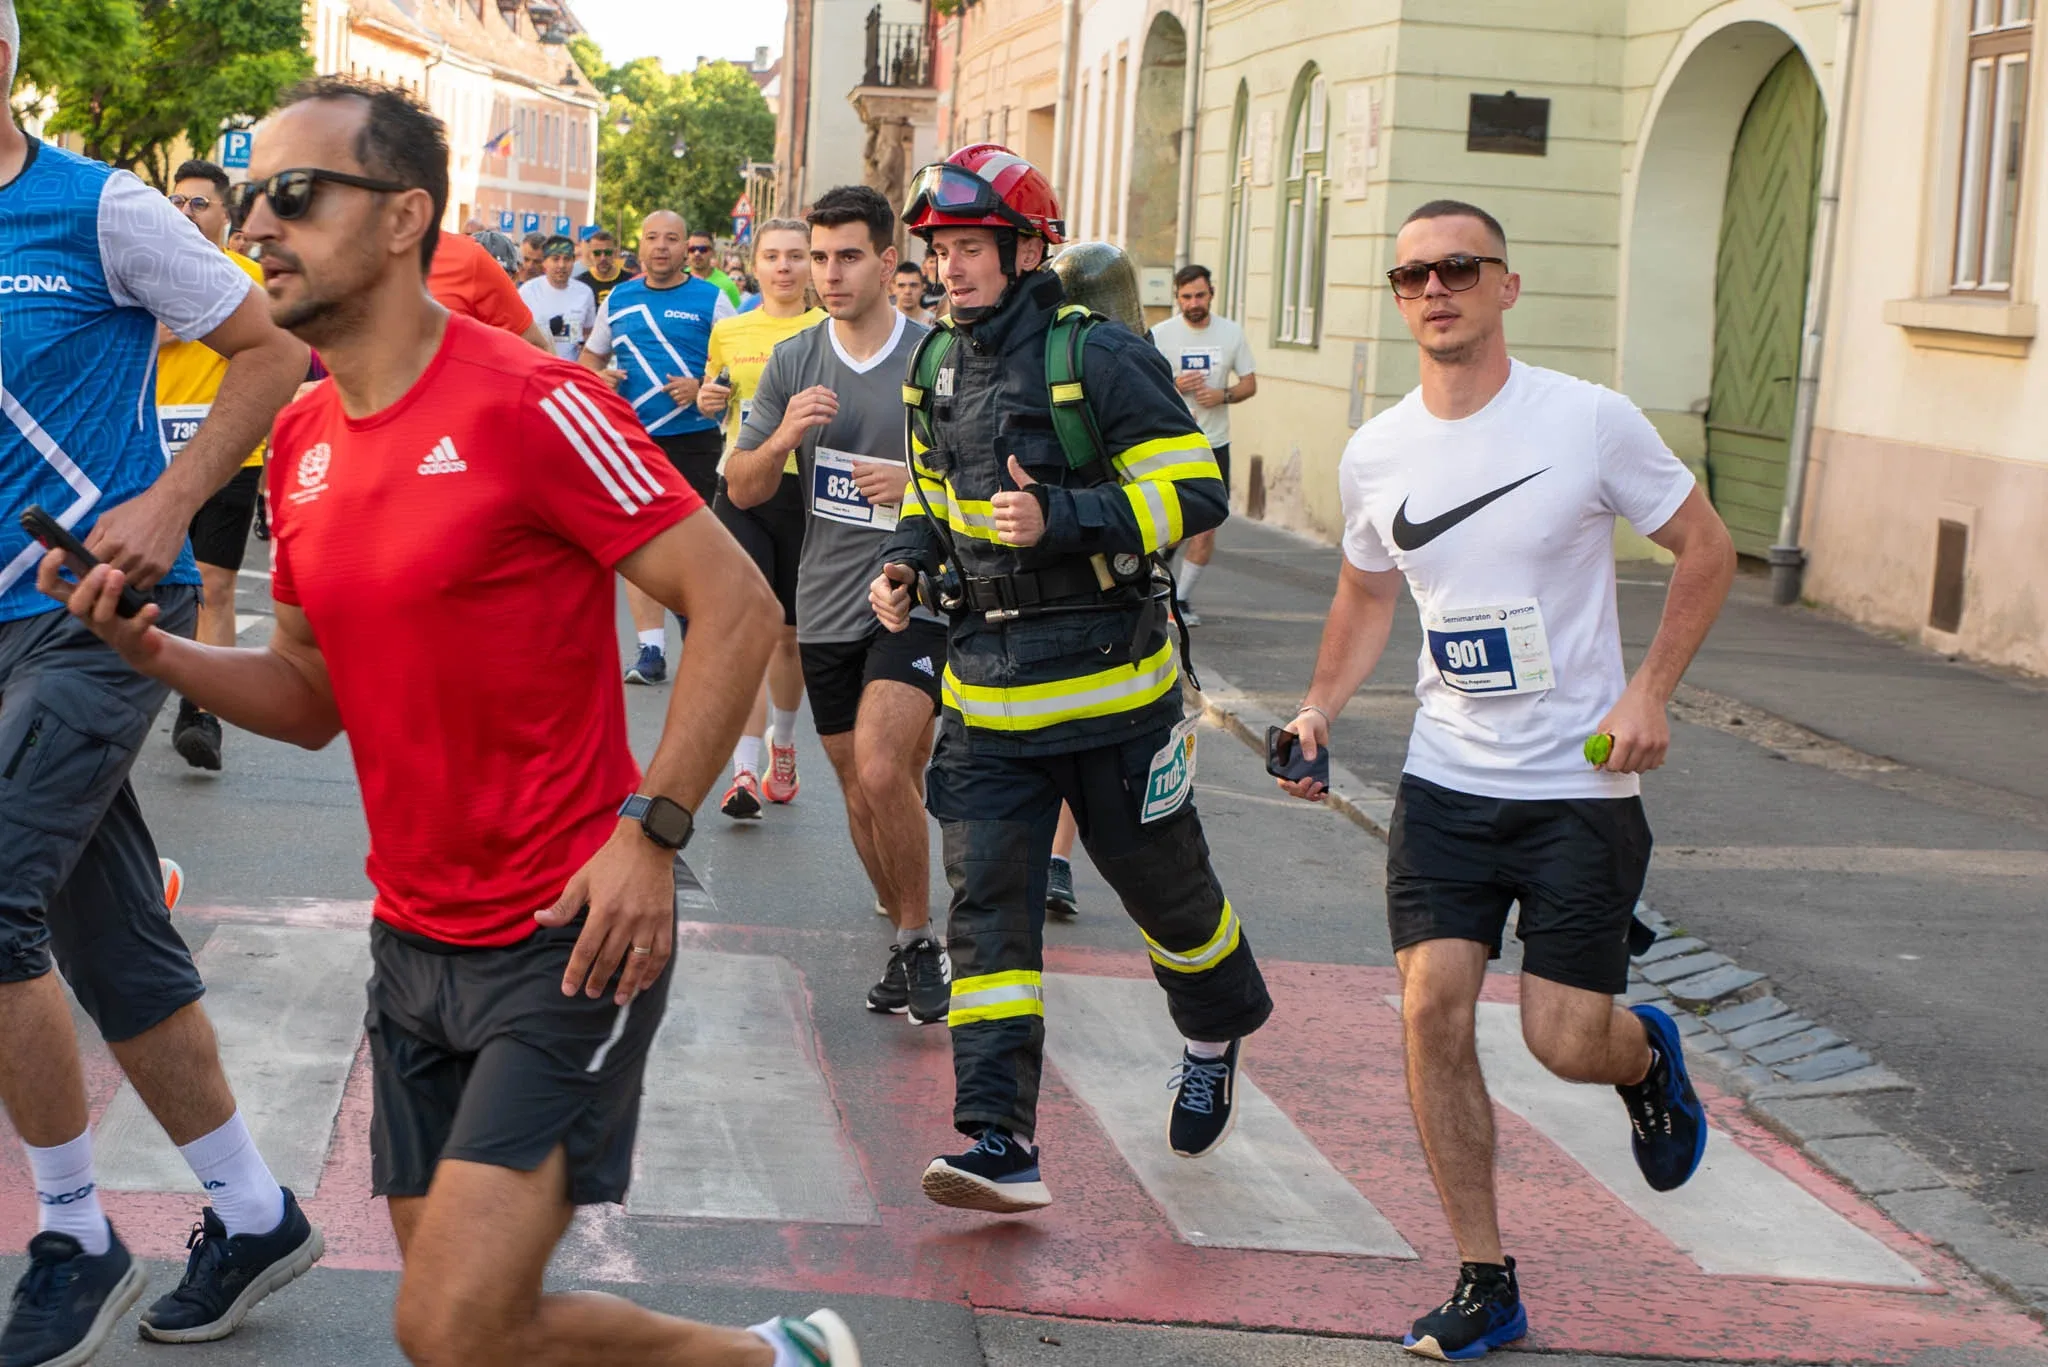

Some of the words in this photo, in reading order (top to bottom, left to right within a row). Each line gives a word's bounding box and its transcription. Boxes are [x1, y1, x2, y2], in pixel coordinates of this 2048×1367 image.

[230, 134, 247, 156] P
[526, 213, 537, 229] P
[558, 218, 568, 231] P
[417, 460, 468, 476] adidas
[827, 474, 861, 502] 832
[1442, 613, 1492, 624] Semimaraton
[1445, 639, 1489, 669] 901
